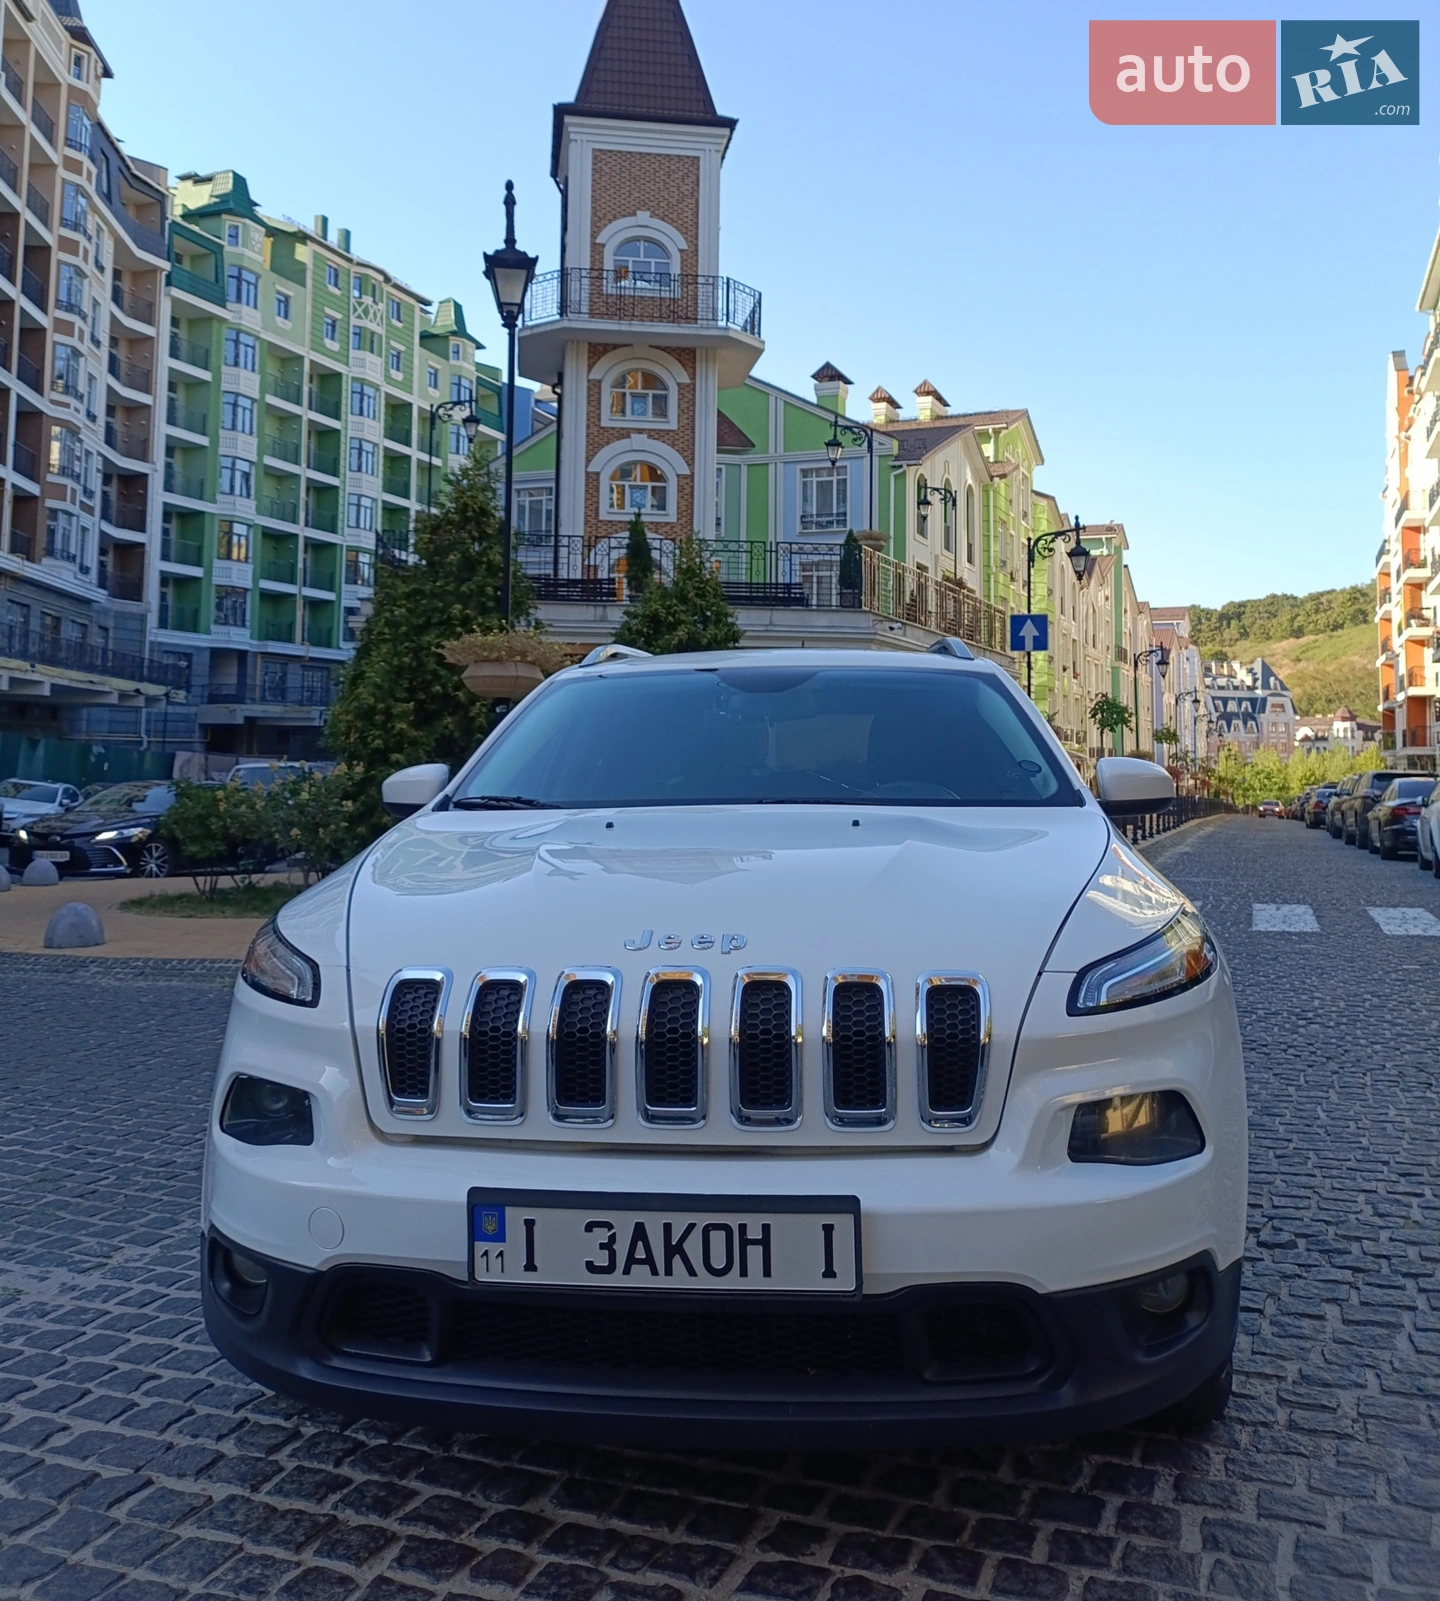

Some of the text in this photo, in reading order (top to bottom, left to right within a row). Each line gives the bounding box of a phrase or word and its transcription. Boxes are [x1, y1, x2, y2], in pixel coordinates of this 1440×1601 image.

[624, 929, 748, 955] Jeep
[479, 1248, 504, 1274] 11
[583, 1219, 772, 1278] ЗАКОН
